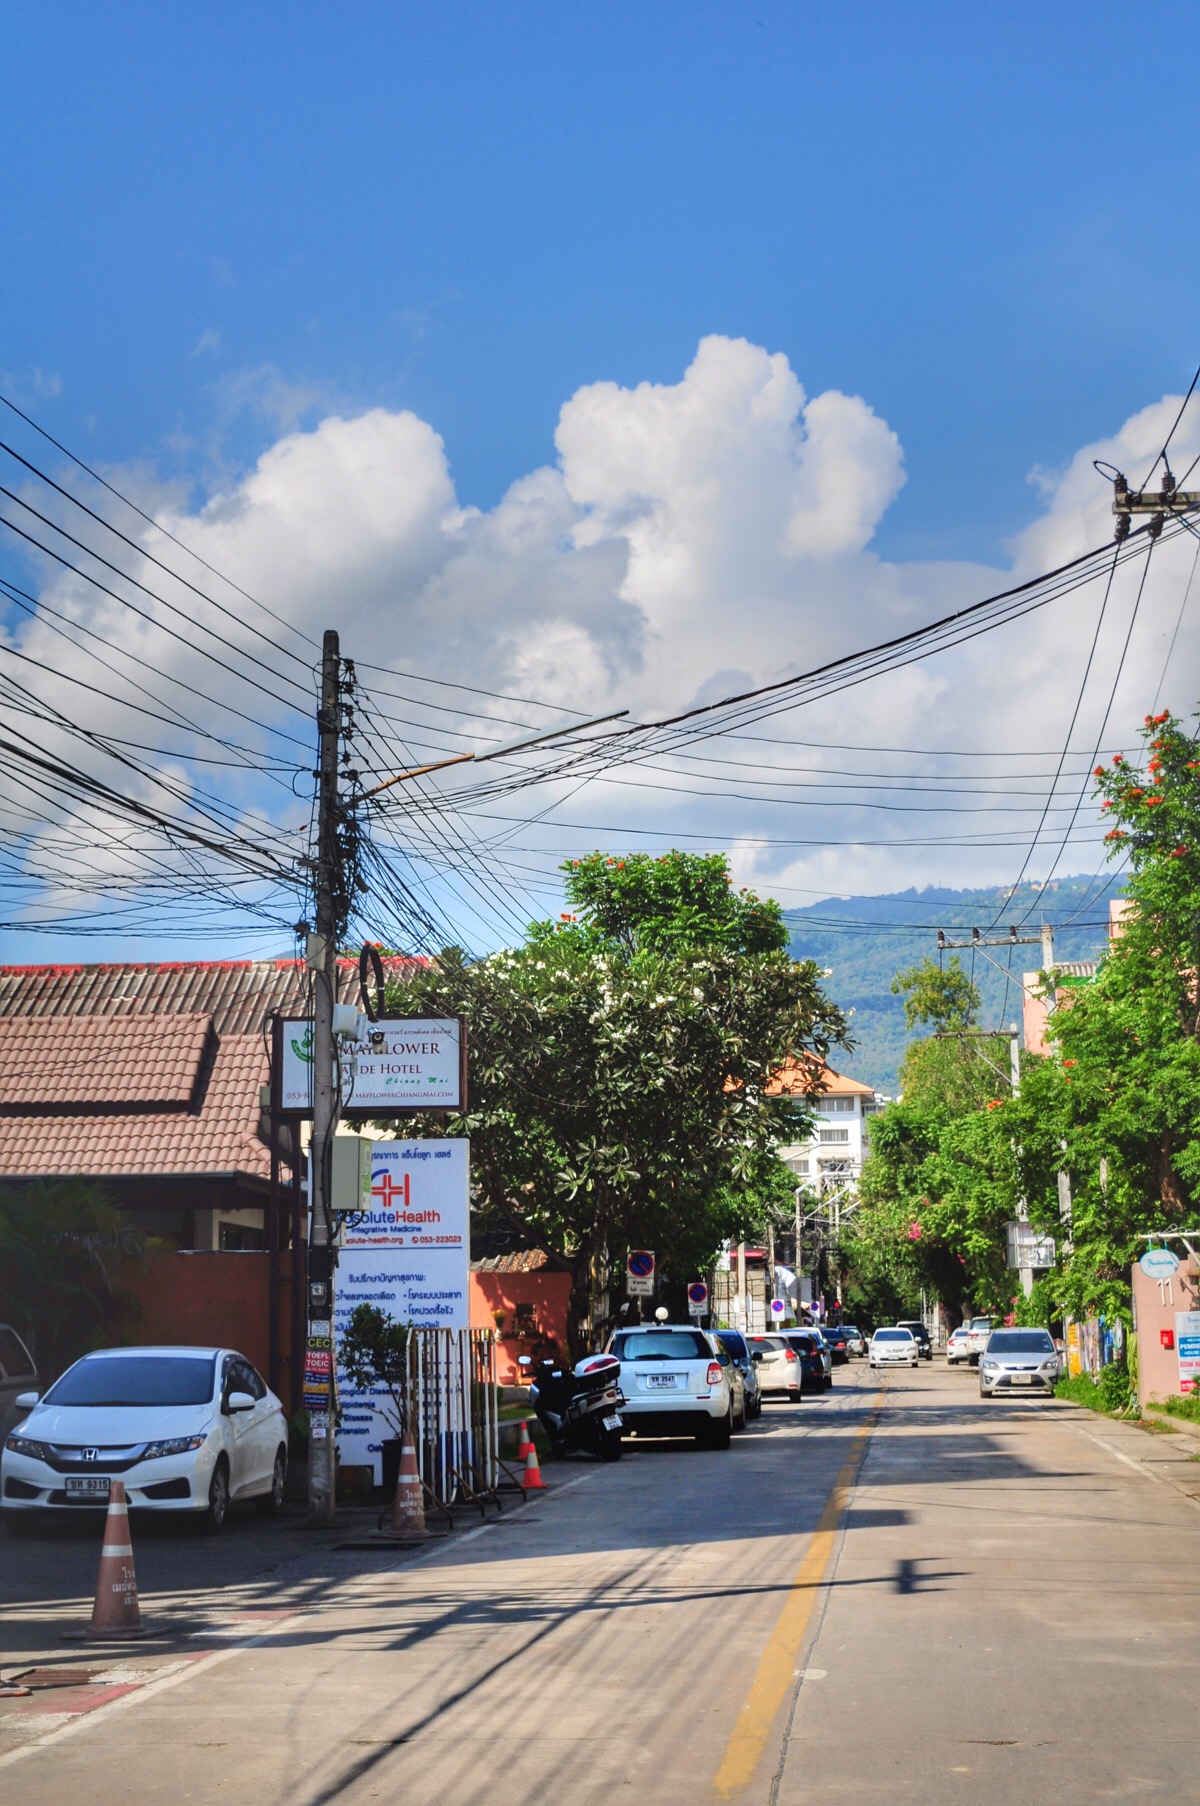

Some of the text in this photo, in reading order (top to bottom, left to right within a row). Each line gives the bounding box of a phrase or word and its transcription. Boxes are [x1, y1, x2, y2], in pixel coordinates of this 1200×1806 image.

[342, 1042, 441, 1056] MAYLOWER
[380, 1063, 422, 1075] HOTEL
[385, 1076, 449, 1085] Chiang Mai
[351, 1225, 422, 1235] Integrative Medicine
[420, 1235, 462, 1244] 053-223023
[1157, 1278, 1175, 1307] 11
[307, 1338, 331, 1348] CEC
[87, 1480, 108, 1489] 9315
